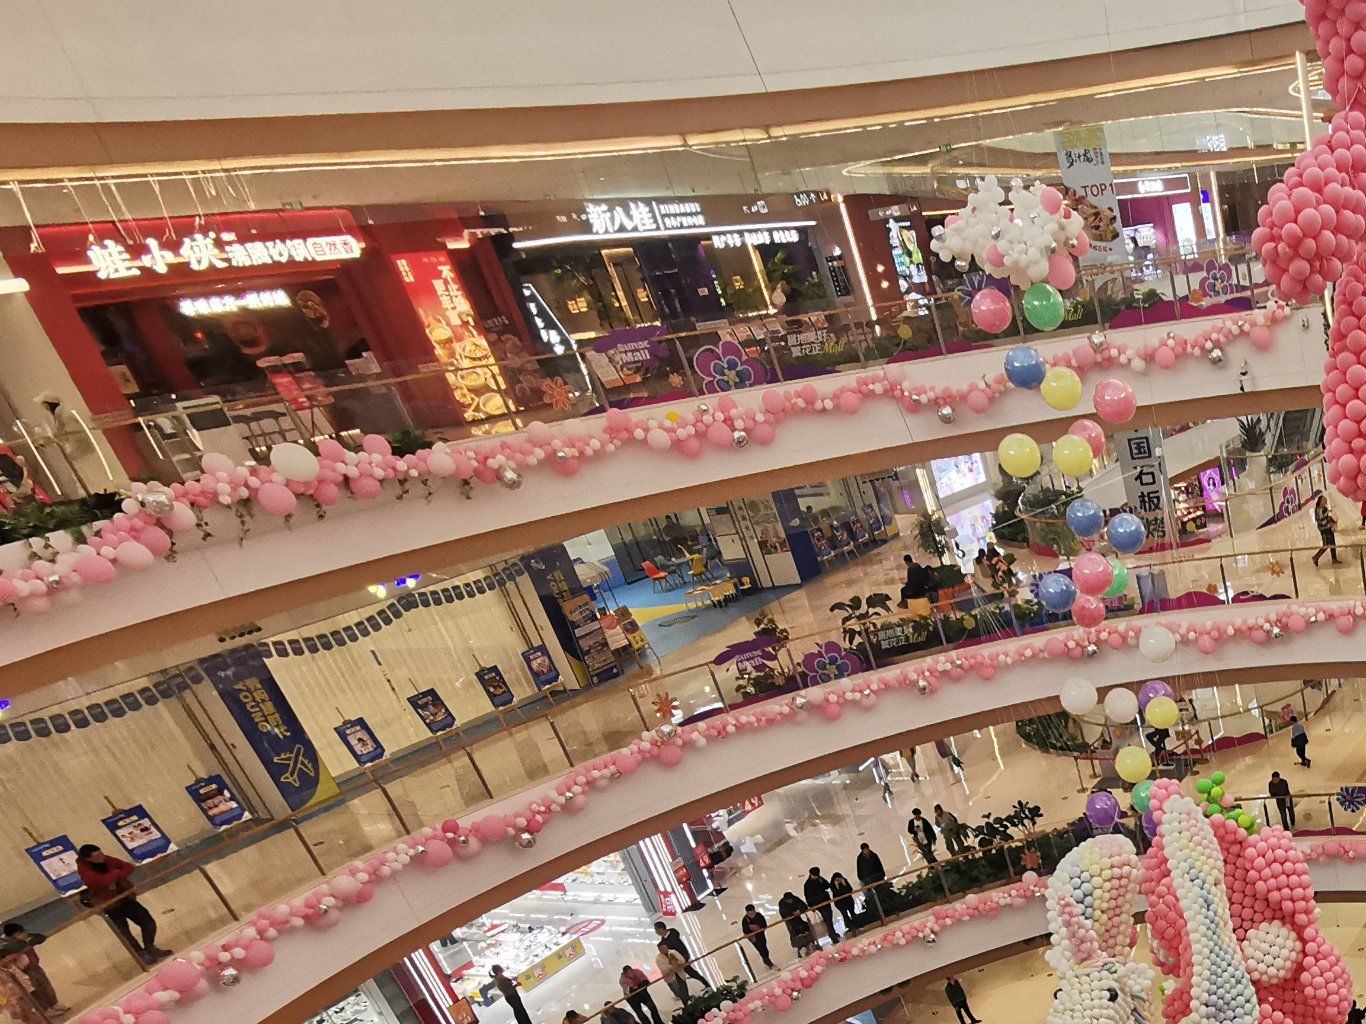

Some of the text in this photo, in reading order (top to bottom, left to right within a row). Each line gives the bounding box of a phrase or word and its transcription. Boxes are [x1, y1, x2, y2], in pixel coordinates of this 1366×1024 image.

[1080, 182, 1115, 198] TOP1
[586, 200, 656, 235] 新八桂
[621, 348, 652, 363] Mall
